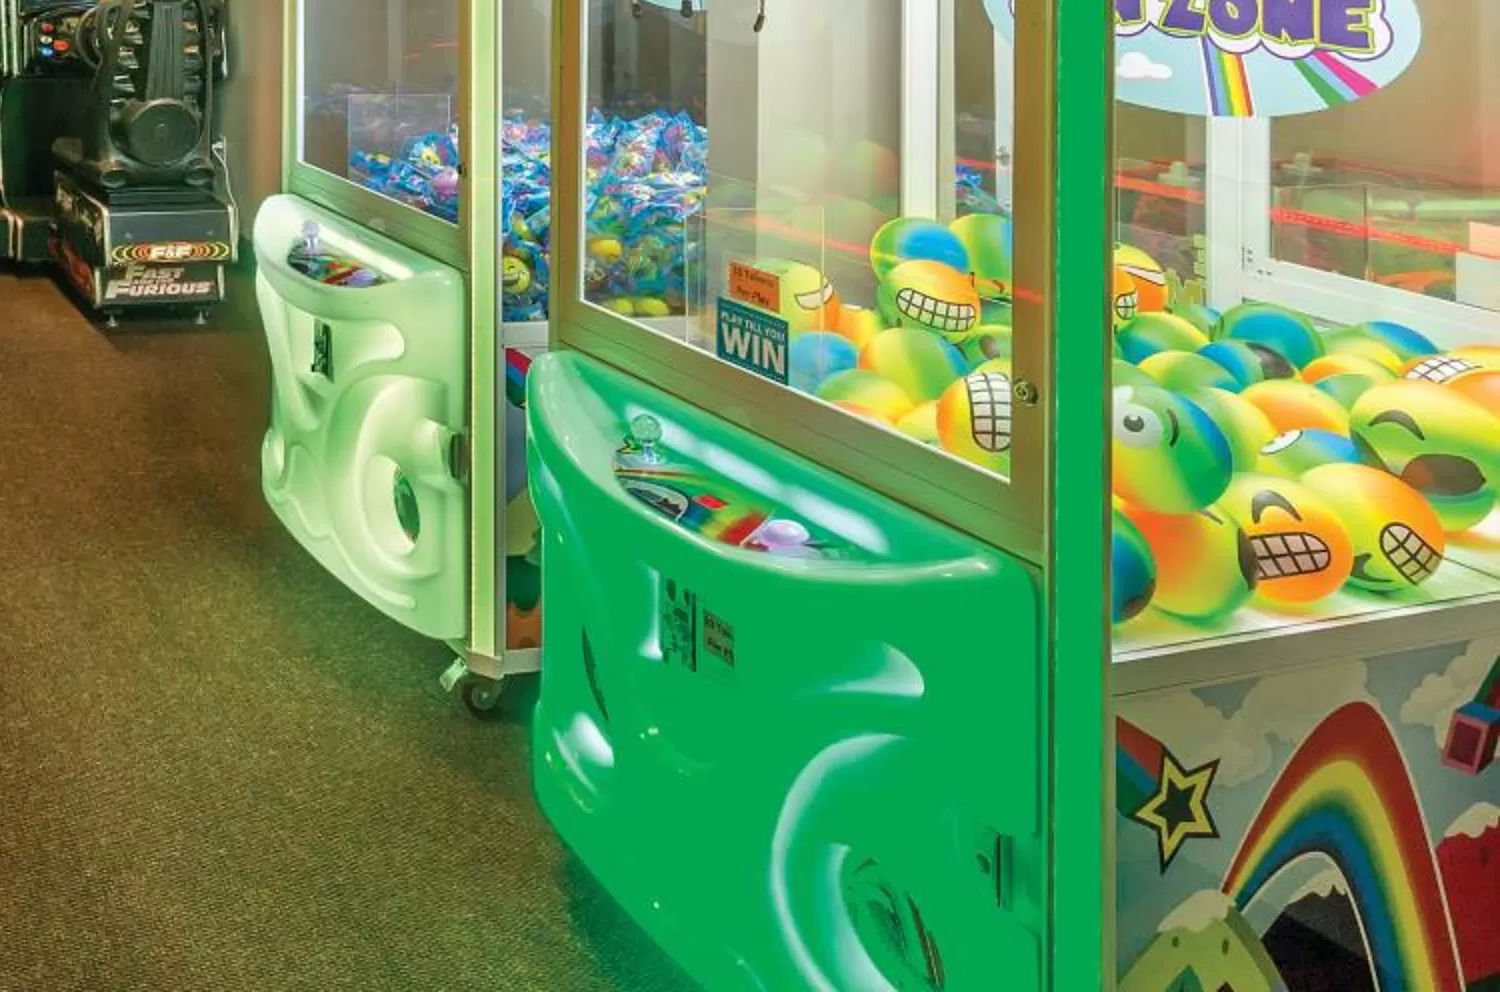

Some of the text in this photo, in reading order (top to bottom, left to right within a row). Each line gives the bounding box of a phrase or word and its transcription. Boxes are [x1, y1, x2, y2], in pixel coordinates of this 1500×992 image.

[126, 265, 185, 280] FAST
[104, 280, 215, 299] FURIOUS
[721, 322, 786, 376] WIN
